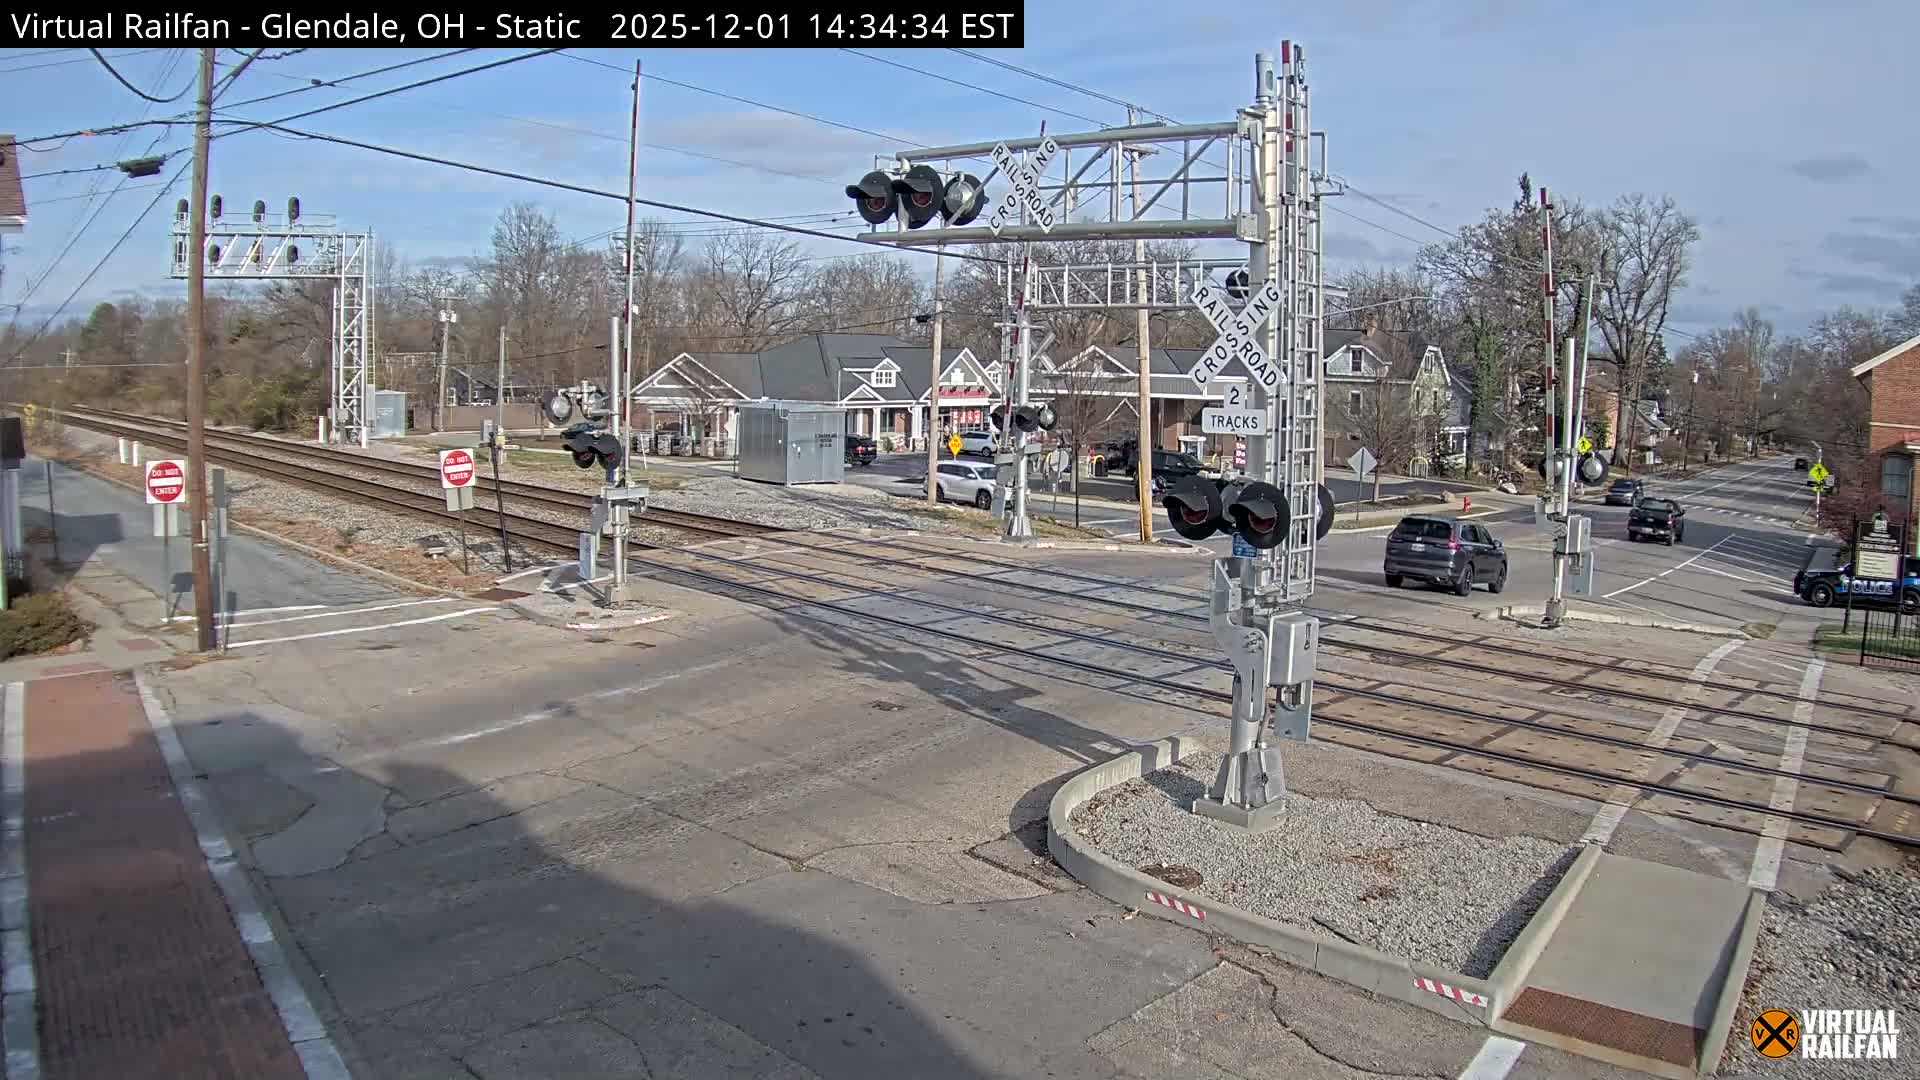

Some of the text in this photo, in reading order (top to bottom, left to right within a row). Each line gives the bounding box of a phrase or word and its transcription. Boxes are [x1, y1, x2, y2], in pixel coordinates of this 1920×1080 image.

[990, 140, 1055, 229] CROSSING
[993, 145, 1054, 227] RAILROAD
[1194, 286, 1279, 384] CROSSING
[1195, 287, 1277, 386] RAILROAD
[1229, 388, 1240, 405] 2
[1210, 415, 1258, 429] TRACKS
[152, 468, 178, 477] DO NOT
[450, 472, 469, 481] ENTER
[155, 487, 177, 495] ENTER
